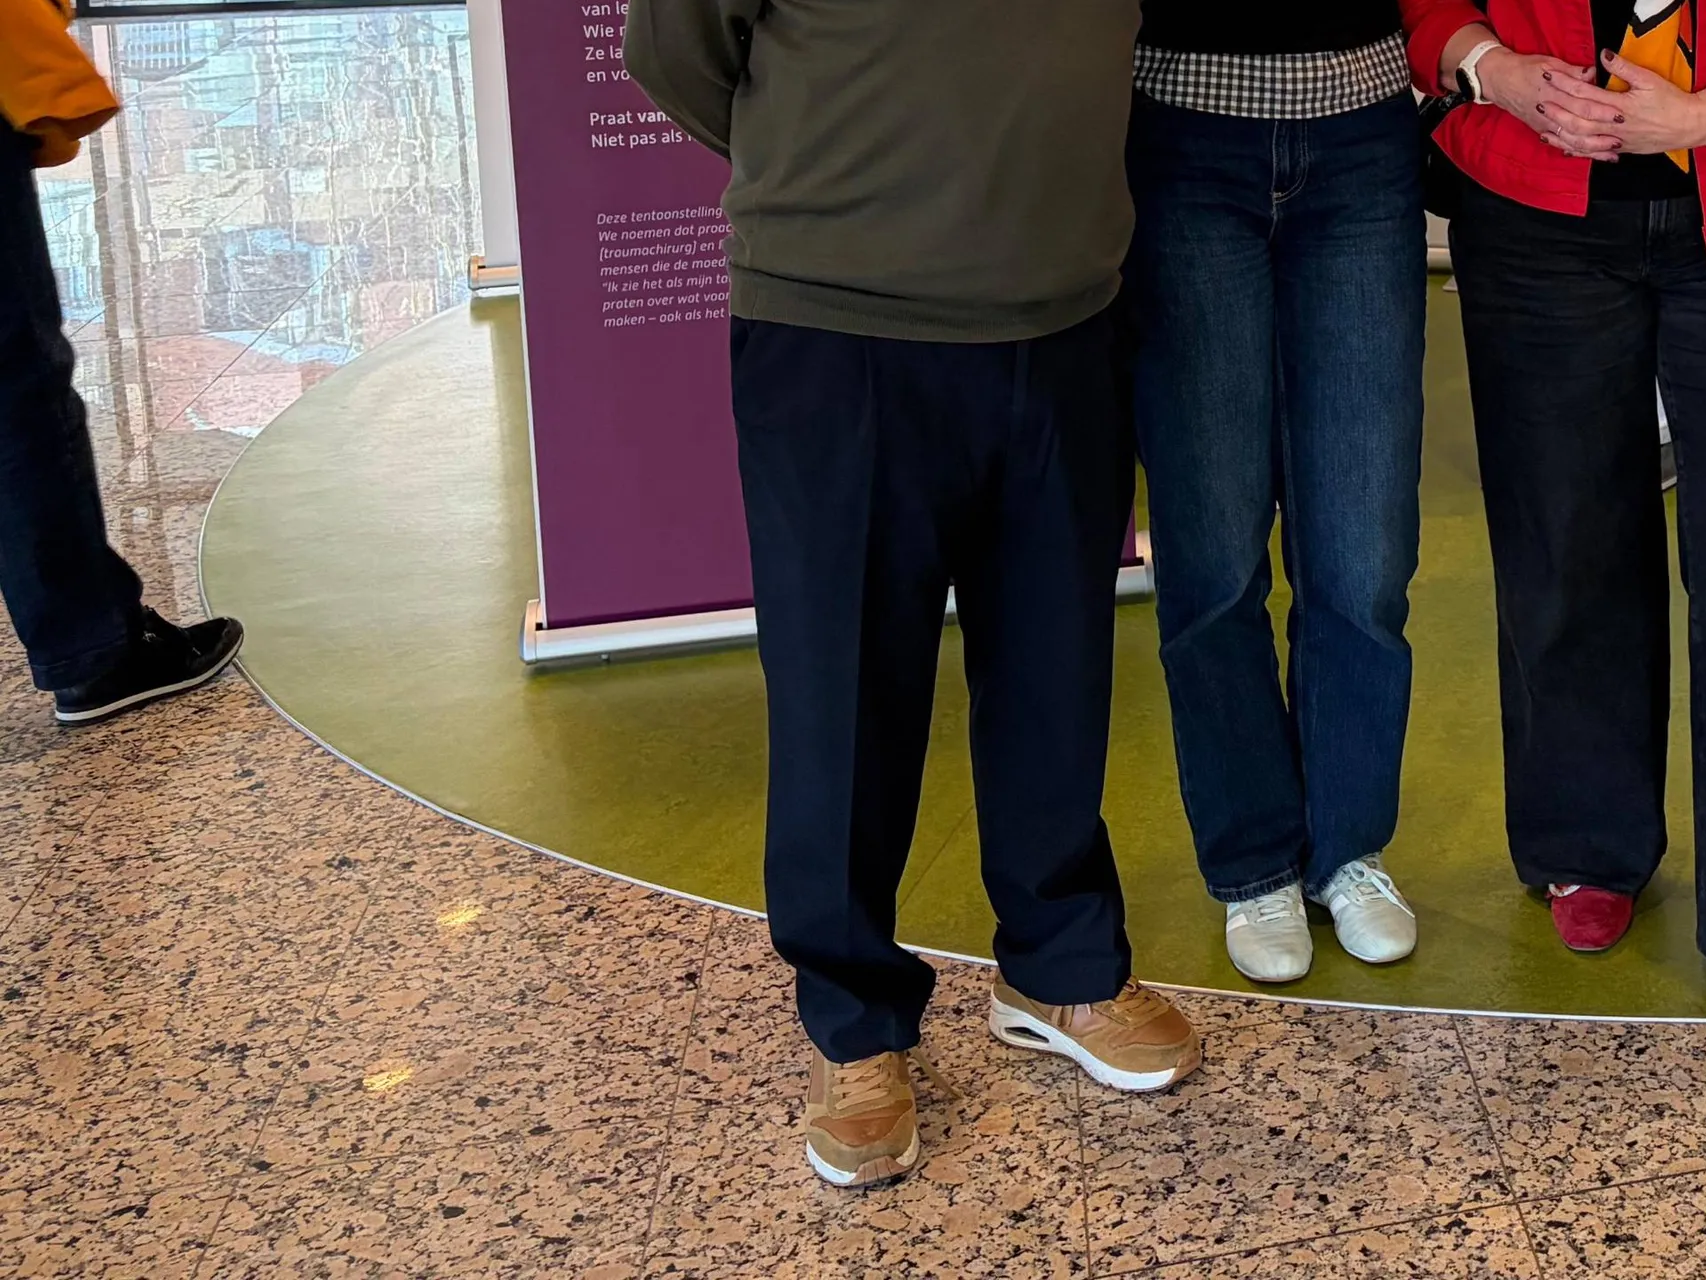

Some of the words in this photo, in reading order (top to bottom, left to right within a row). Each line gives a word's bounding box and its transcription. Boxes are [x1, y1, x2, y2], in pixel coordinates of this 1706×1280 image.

[581, 4, 611, 17] van
[583, 24, 614, 39] Wie
[584, 46, 605, 61] Ze
[586, 71, 607, 83] en
[589, 110, 634, 126] Praat
[637, 111, 671, 123] van
[591, 132, 625, 148] Niet
[629, 132, 657, 149] pas
[661, 128, 683, 143] als
[597, 213, 628, 225] Deze
[631, 206, 723, 223] tentoonstelling
[598, 230, 618, 242] We
[621, 227, 671, 240] noemen
[674, 224, 695, 236] dat
[697, 223, 733, 237] proac
[700, 241, 715, 252] en
[600, 263, 649, 277] mensen
[652, 260, 671, 273] die
[673, 259, 689, 270] de
[691, 255, 727, 269] moed
[621, 280, 640, 292] zie
[642, 278, 663, 291] het
[666, 276, 684, 288] als
[686, 274, 713, 288] mijn
[602, 297, 644, 313] praten
[646, 295, 675, 307] over
[677, 292, 700, 305] wat
[703, 291, 730, 302] voor
[603, 314, 646, 328] maken
[659, 310, 682, 323] ook
[685, 308, 702, 321] als
[704, 307, 725, 319] het
